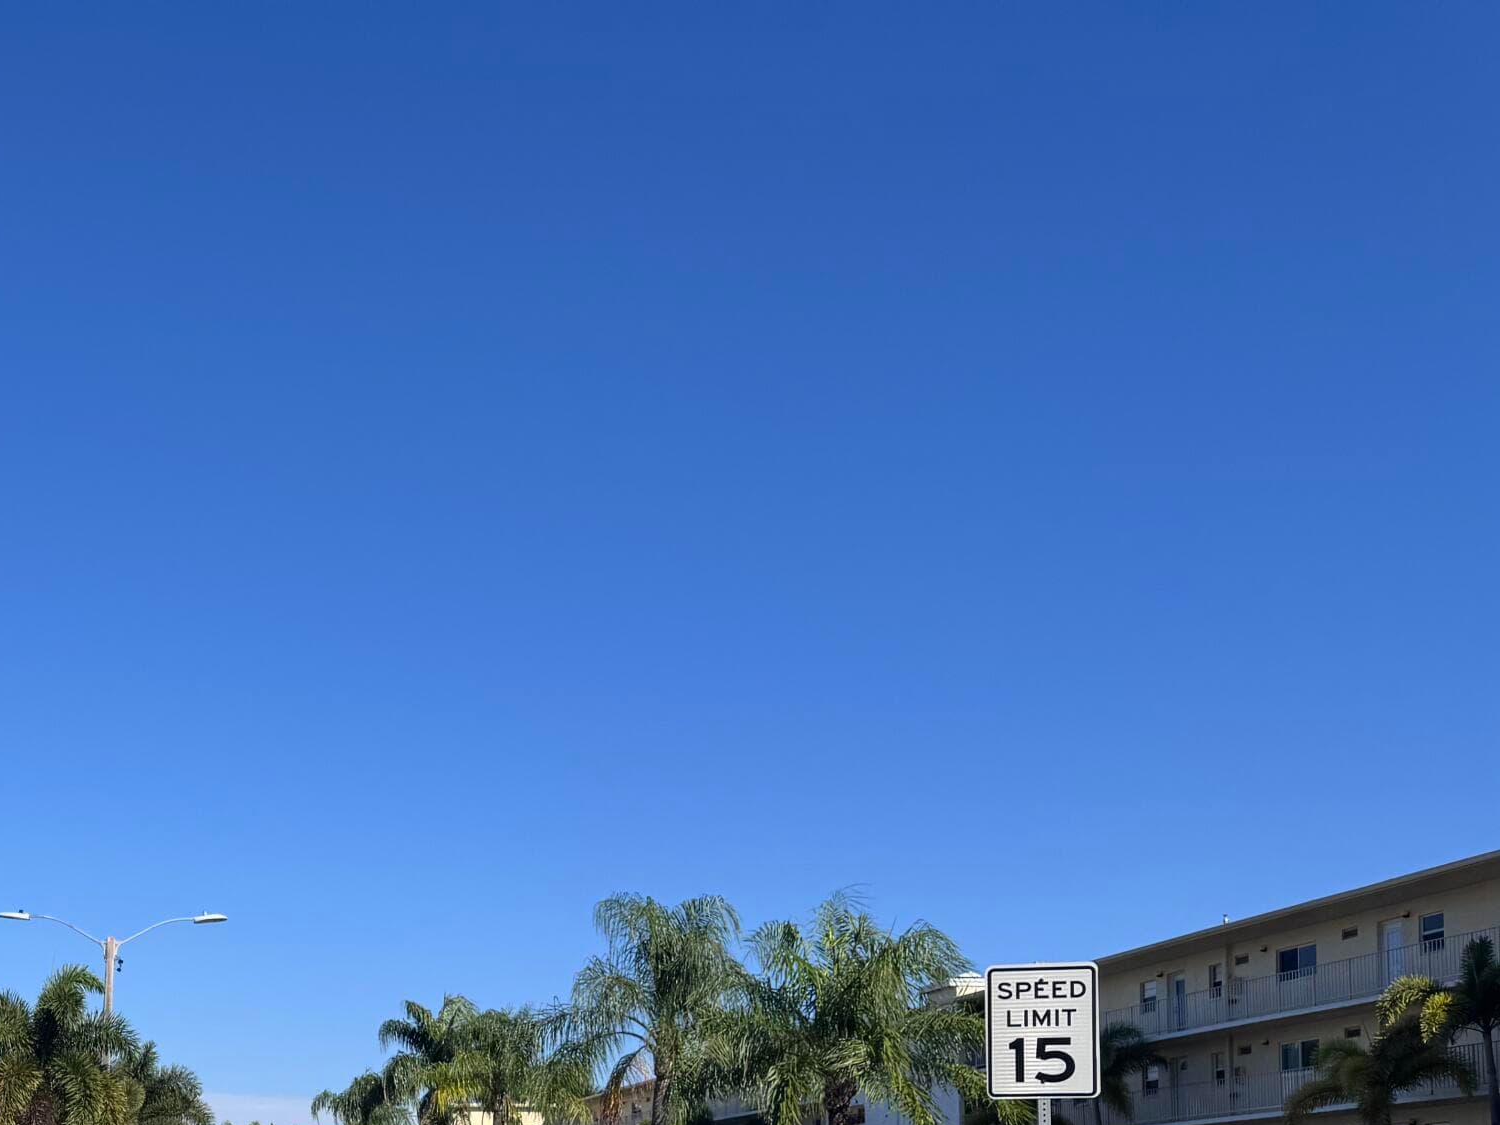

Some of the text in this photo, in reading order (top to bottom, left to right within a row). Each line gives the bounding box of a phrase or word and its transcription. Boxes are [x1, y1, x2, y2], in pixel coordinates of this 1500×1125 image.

[997, 980, 1086, 999] SPEED
[1007, 1009, 1076, 1027] LIMIT
[1009, 1037, 1076, 1083] 15
